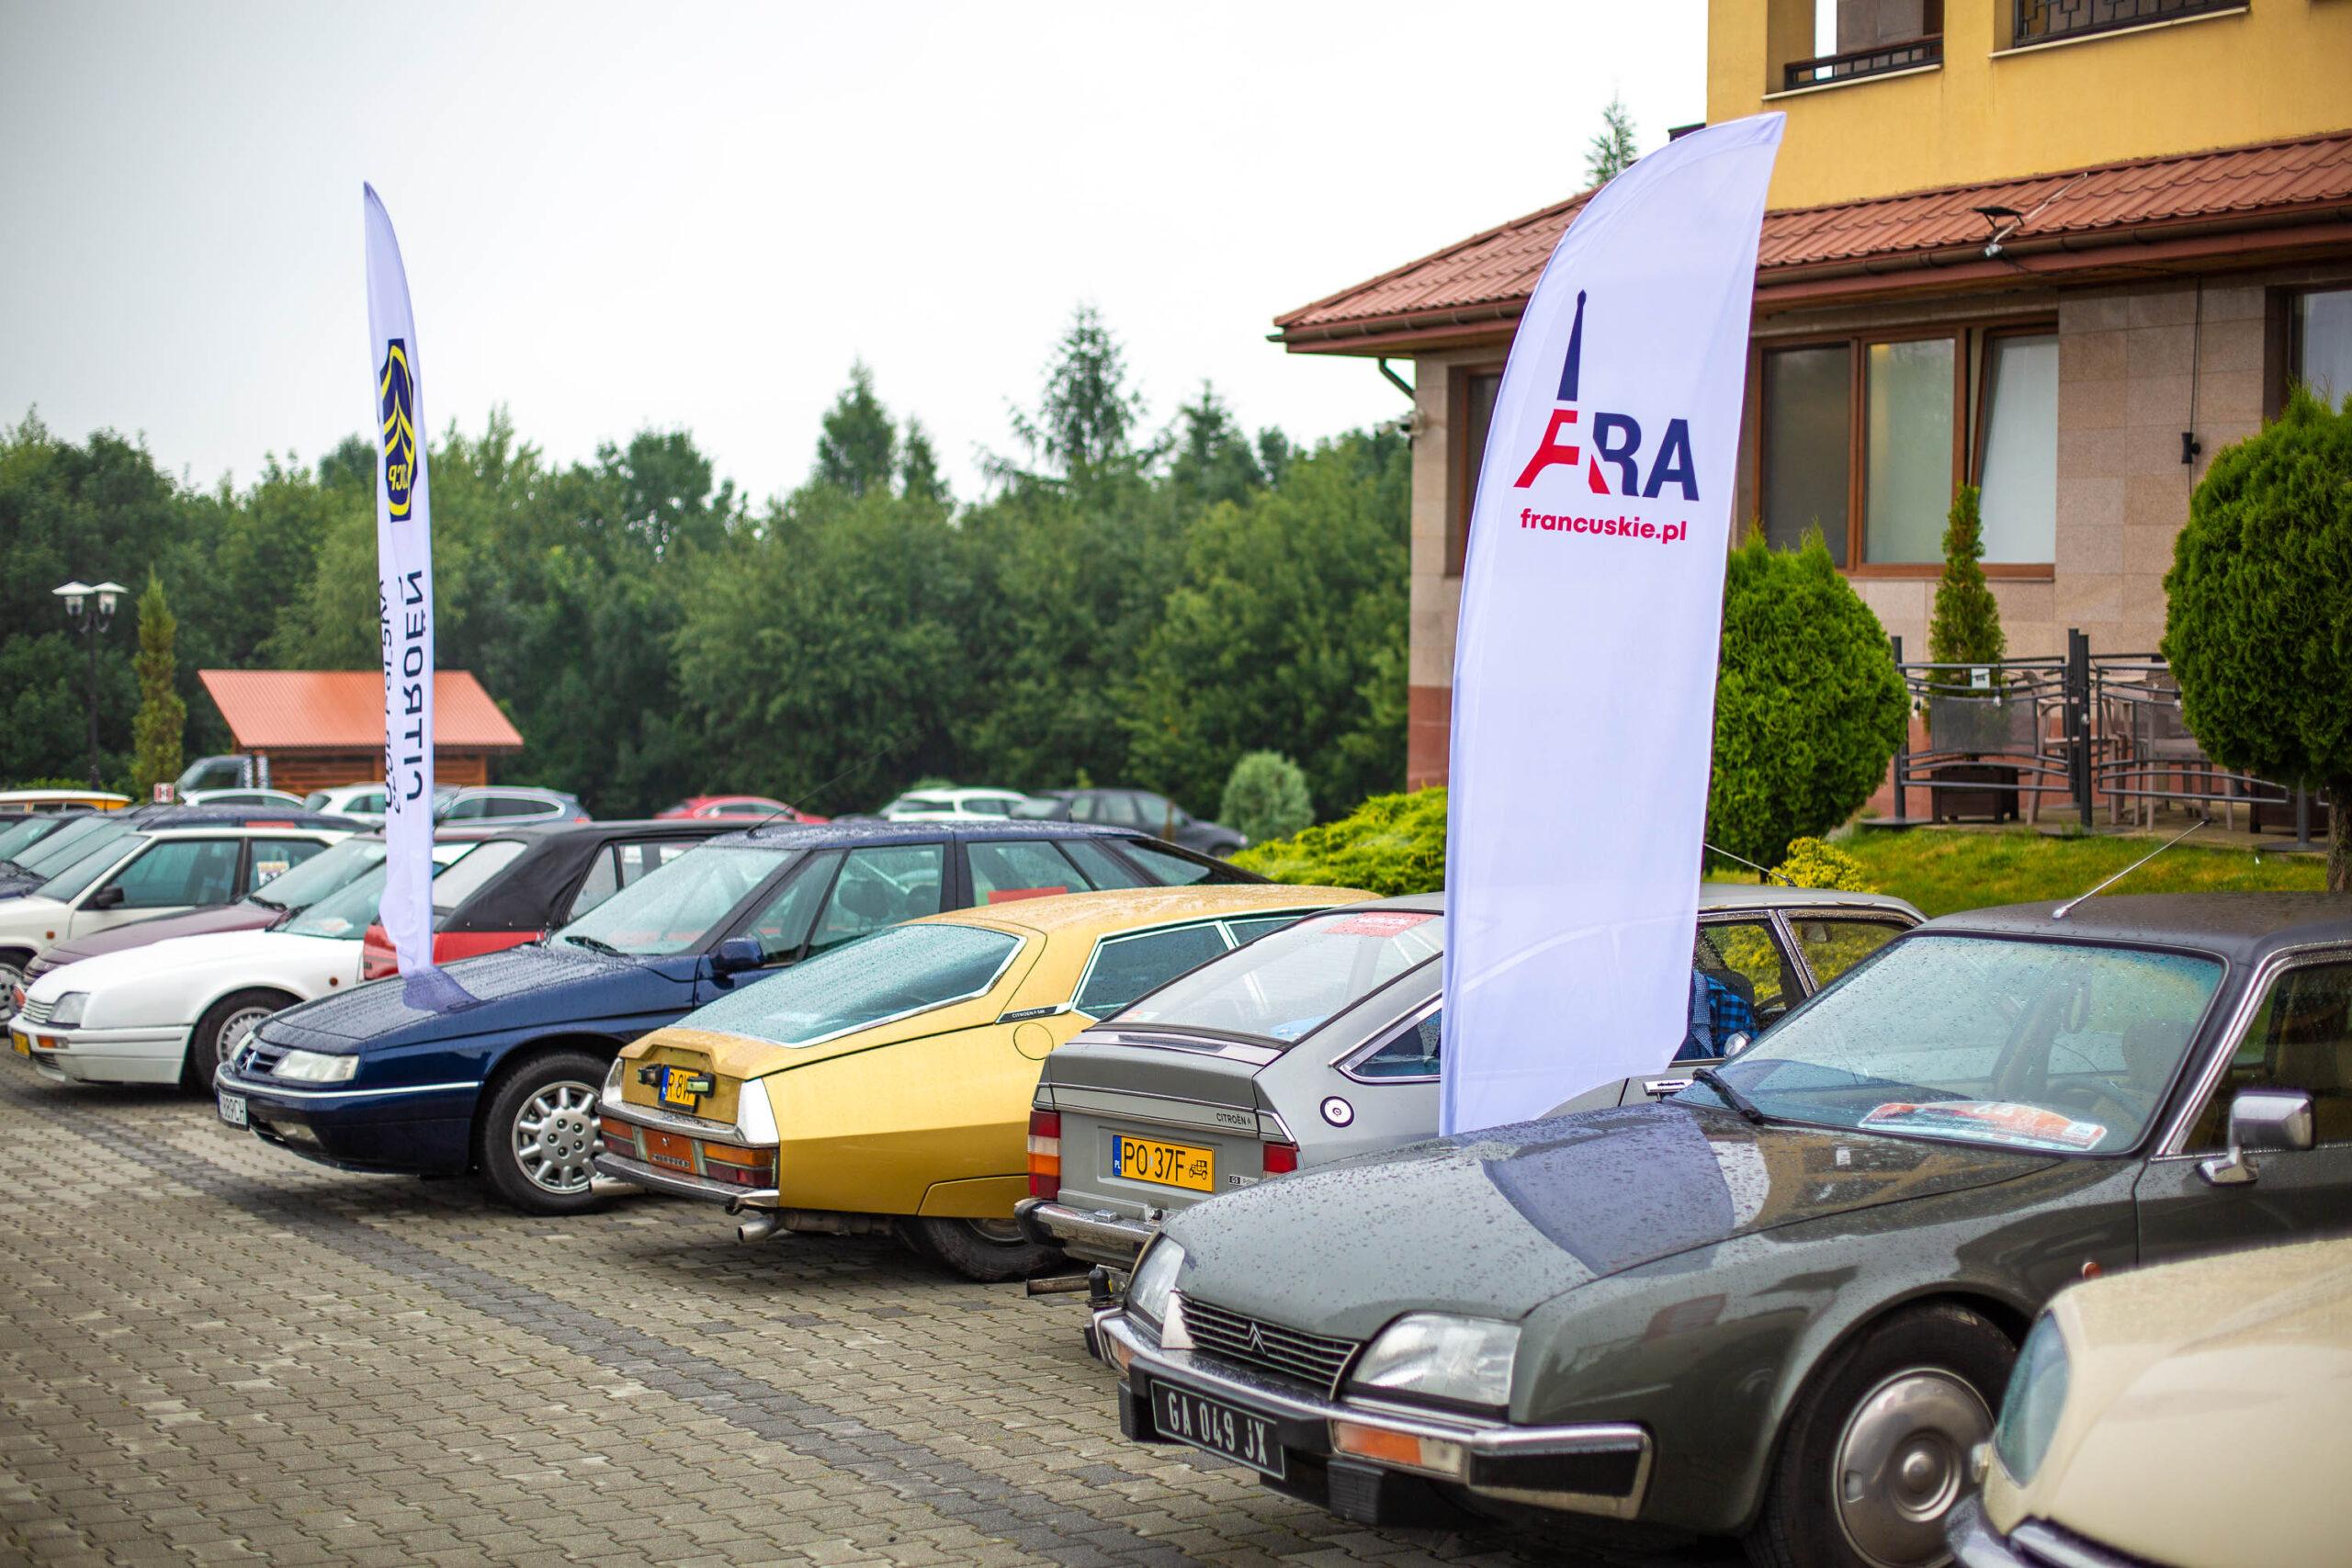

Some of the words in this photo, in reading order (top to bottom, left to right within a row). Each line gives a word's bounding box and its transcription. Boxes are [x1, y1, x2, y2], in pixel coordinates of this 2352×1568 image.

[1520, 508, 1687, 544] francuskie.pl
[1216, 1112, 1247, 1125] CITROËN
[1114, 1160, 1121, 1169] PL
[1124, 1142, 1148, 1176] PO
[1154, 1146, 1186, 1181] 37F
[1168, 1392, 1193, 1438] GA
[1199, 1402, 1236, 1452] 049
[1244, 1418, 1268, 1465] JX
